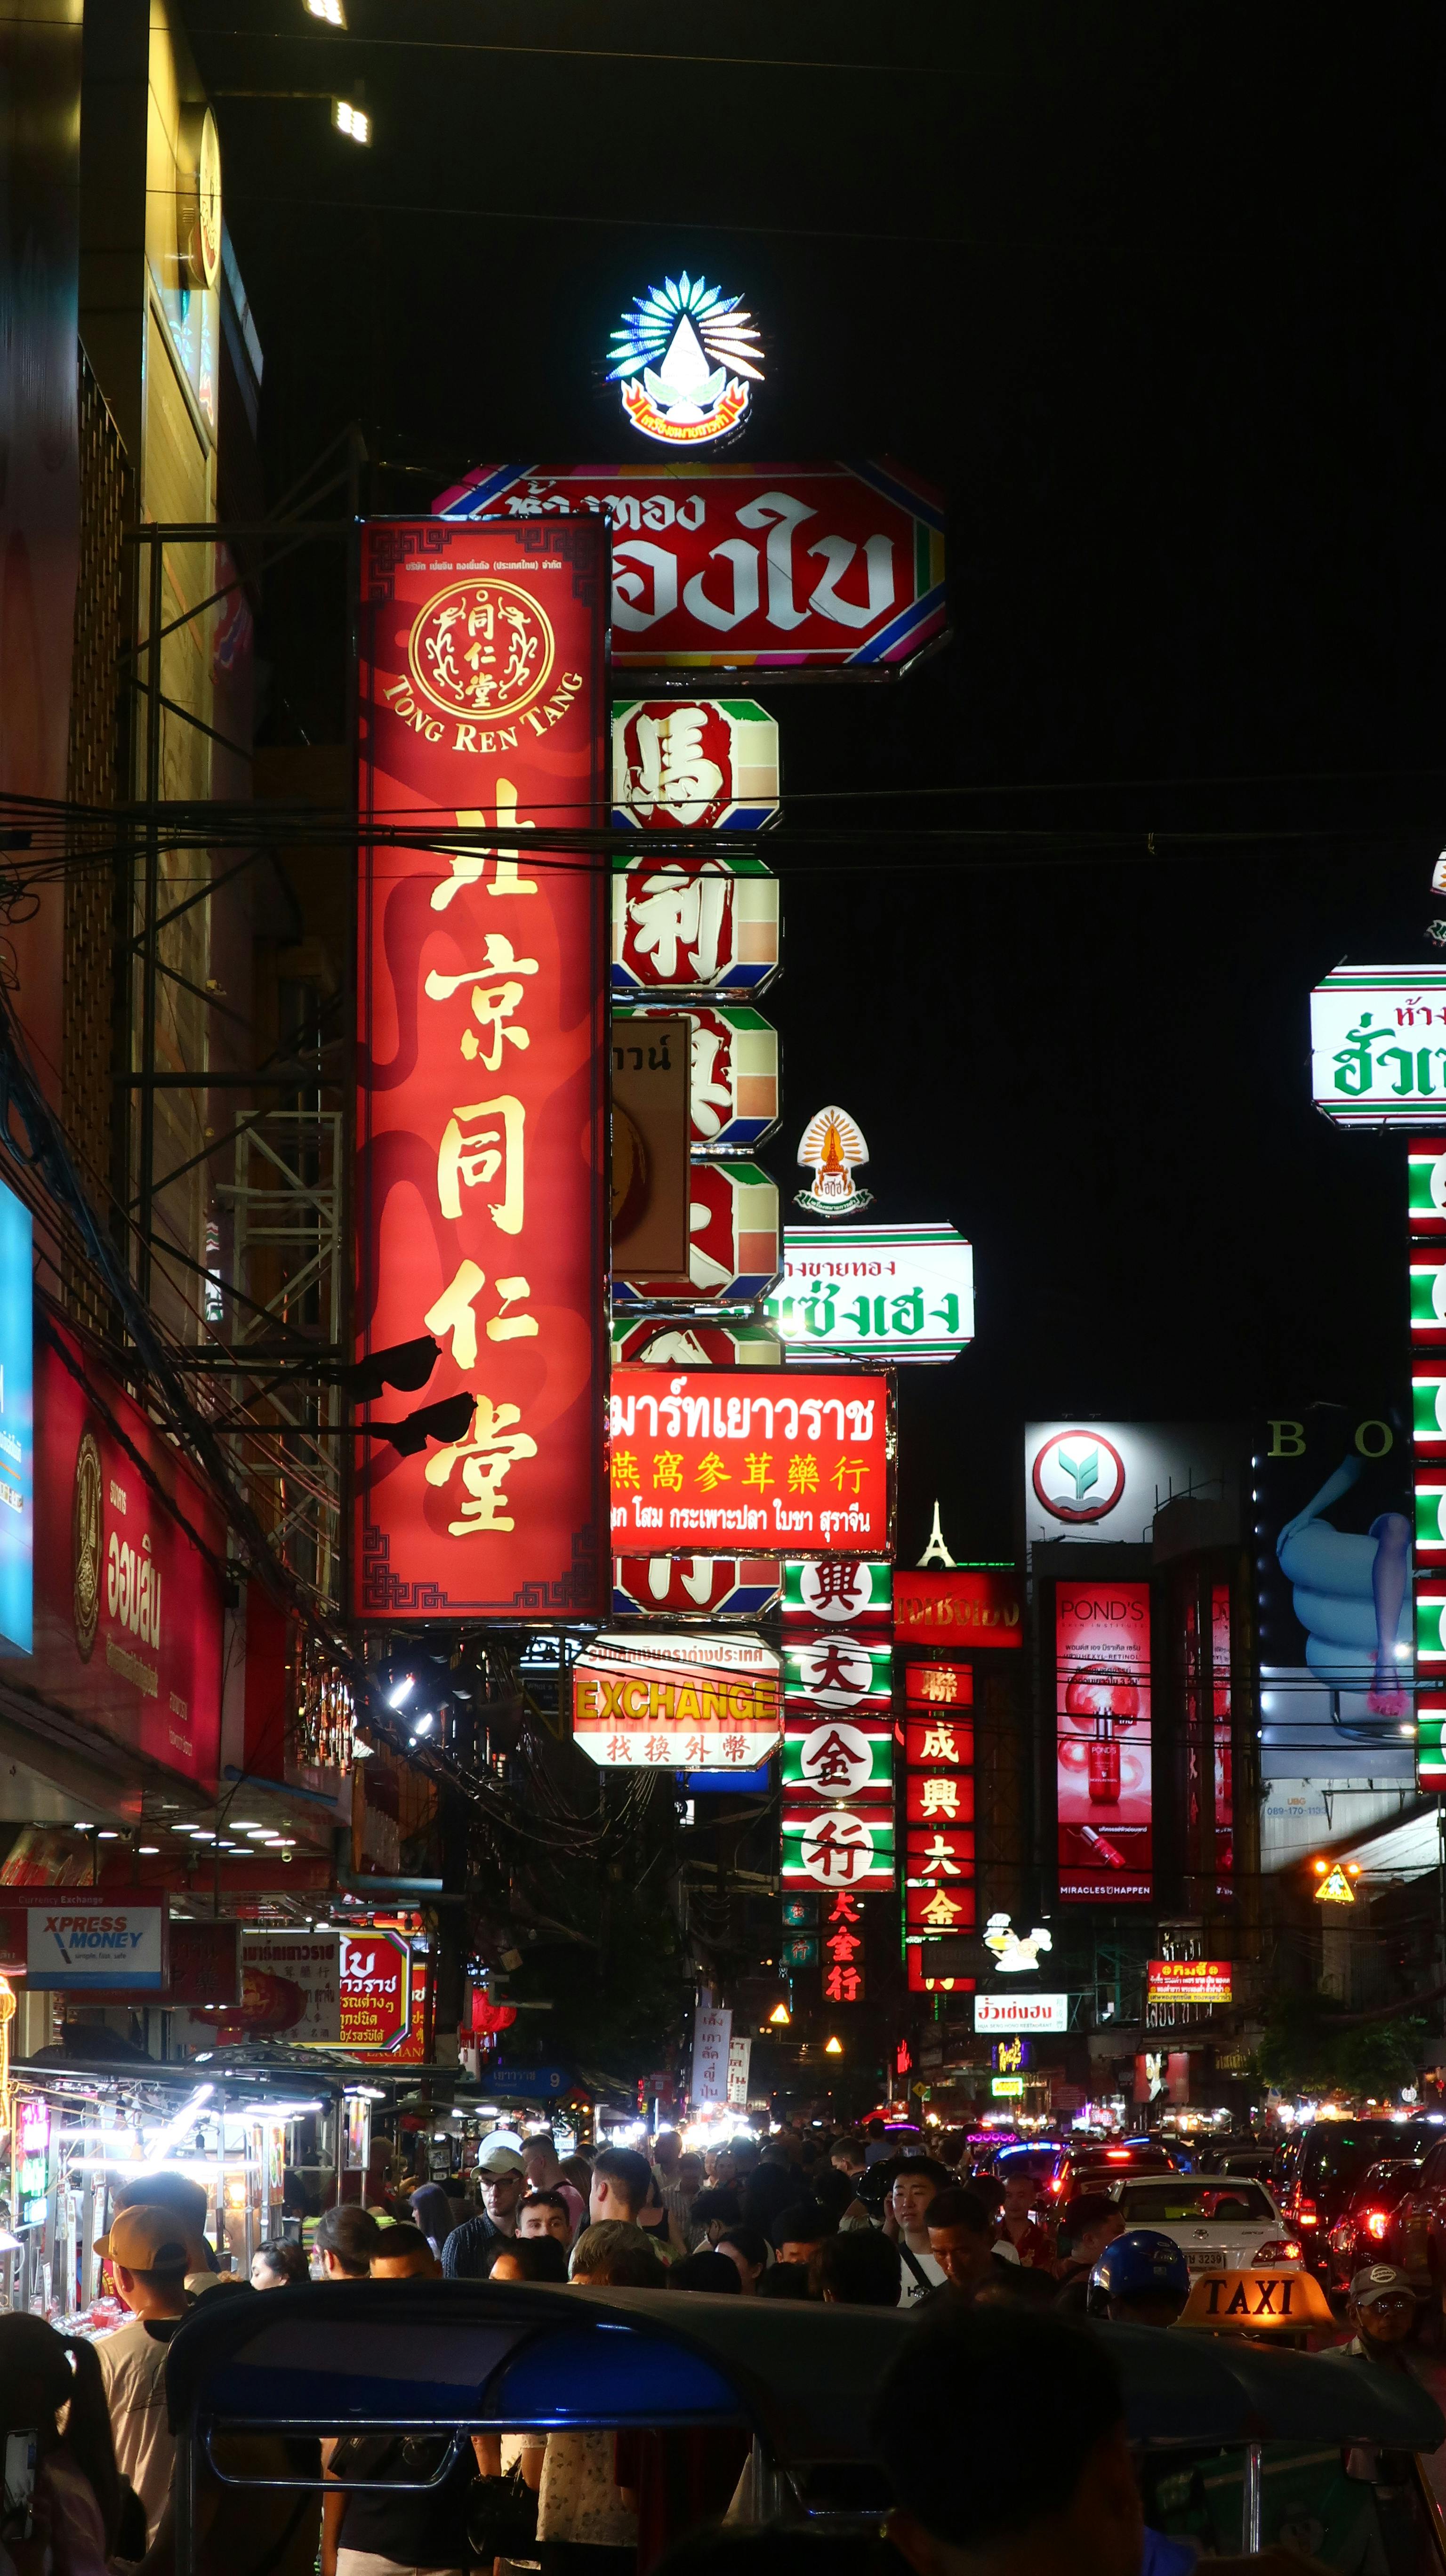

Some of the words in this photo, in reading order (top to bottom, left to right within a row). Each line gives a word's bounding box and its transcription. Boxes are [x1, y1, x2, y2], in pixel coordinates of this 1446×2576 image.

[493, 559, 538, 571] (ประเทศไทย)
[542, 560, 562, 569] จำกัด
[464, 603, 498, 708] 同仁堂
[383, 674, 445, 742] TONG
[452, 723, 518, 753] REN
[518, 671, 584, 737] TANG
[1332, 1012, 1446, 1096] ฮั่วเ
[424, 778, 539, 1536] 北京同仁堂
[612, 1450, 870, 1494] 燕窩參茸藥行
[632, 1496, 663, 1528] โสม
[670, 1504, 767, 1530] กระเพาะปลา
[773, 1498, 813, 1531] ใบชา
[820, 1502, 871, 1542] สุราจีน
[107, 1531, 161, 1650] ออมสิน
[1061, 1600, 1144, 1621] POND'S
[576, 1680, 777, 1720] EXCHANGE
[607, 1735, 751, 1762] 找換外幣
[61, 1895, 104, 1905] Exchange
[1060, 1886, 1105, 1895] MIRACLES
[1114, 1886, 1150, 1895] HAPPEN
[44, 1916, 127, 1932] XPRESS
[69, 1932, 143, 1948] MONEY
[340, 1975, 397, 1993] าวราช
[367, 2047, 424, 2057] EXCHAN
[550, 2072, 561, 2088] 9
[1198, 2254, 1222, 2264] 3239
[1204, 2279, 1294, 2315] TAXI
